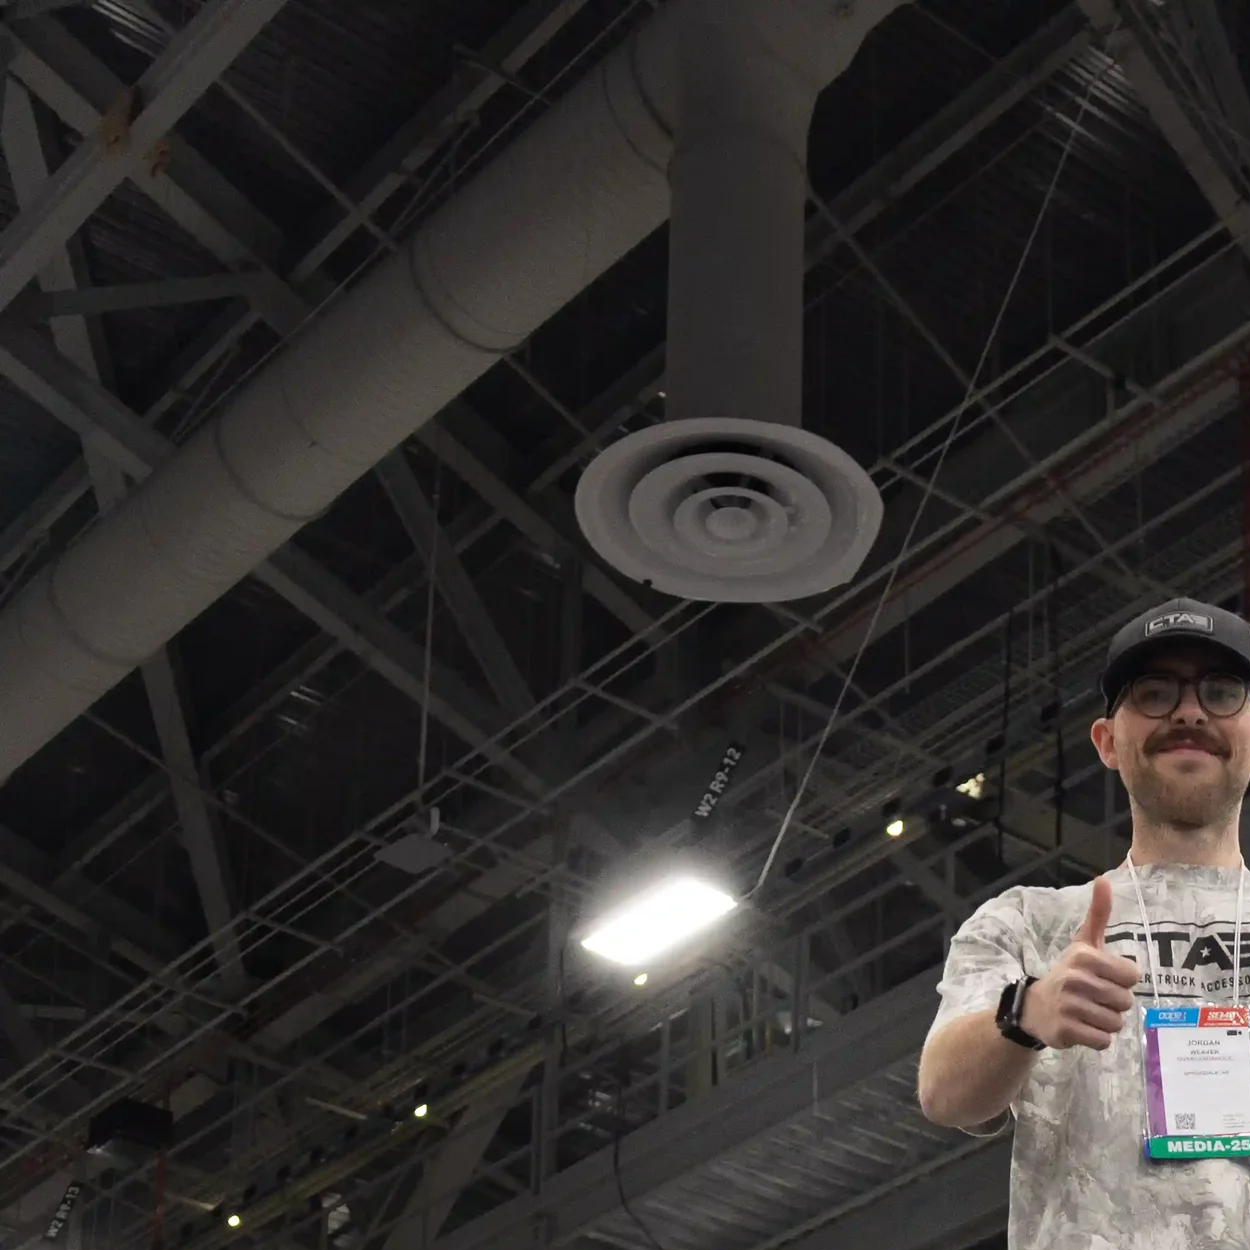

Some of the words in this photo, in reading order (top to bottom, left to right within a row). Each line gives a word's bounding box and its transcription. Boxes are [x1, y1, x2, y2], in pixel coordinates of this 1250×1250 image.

[694, 793, 718, 817] W2
[709, 747, 741, 794] R9-12
[1157, 973, 1196, 987] TRUCK
[1187, 1039, 1221, 1047] JORDAN
